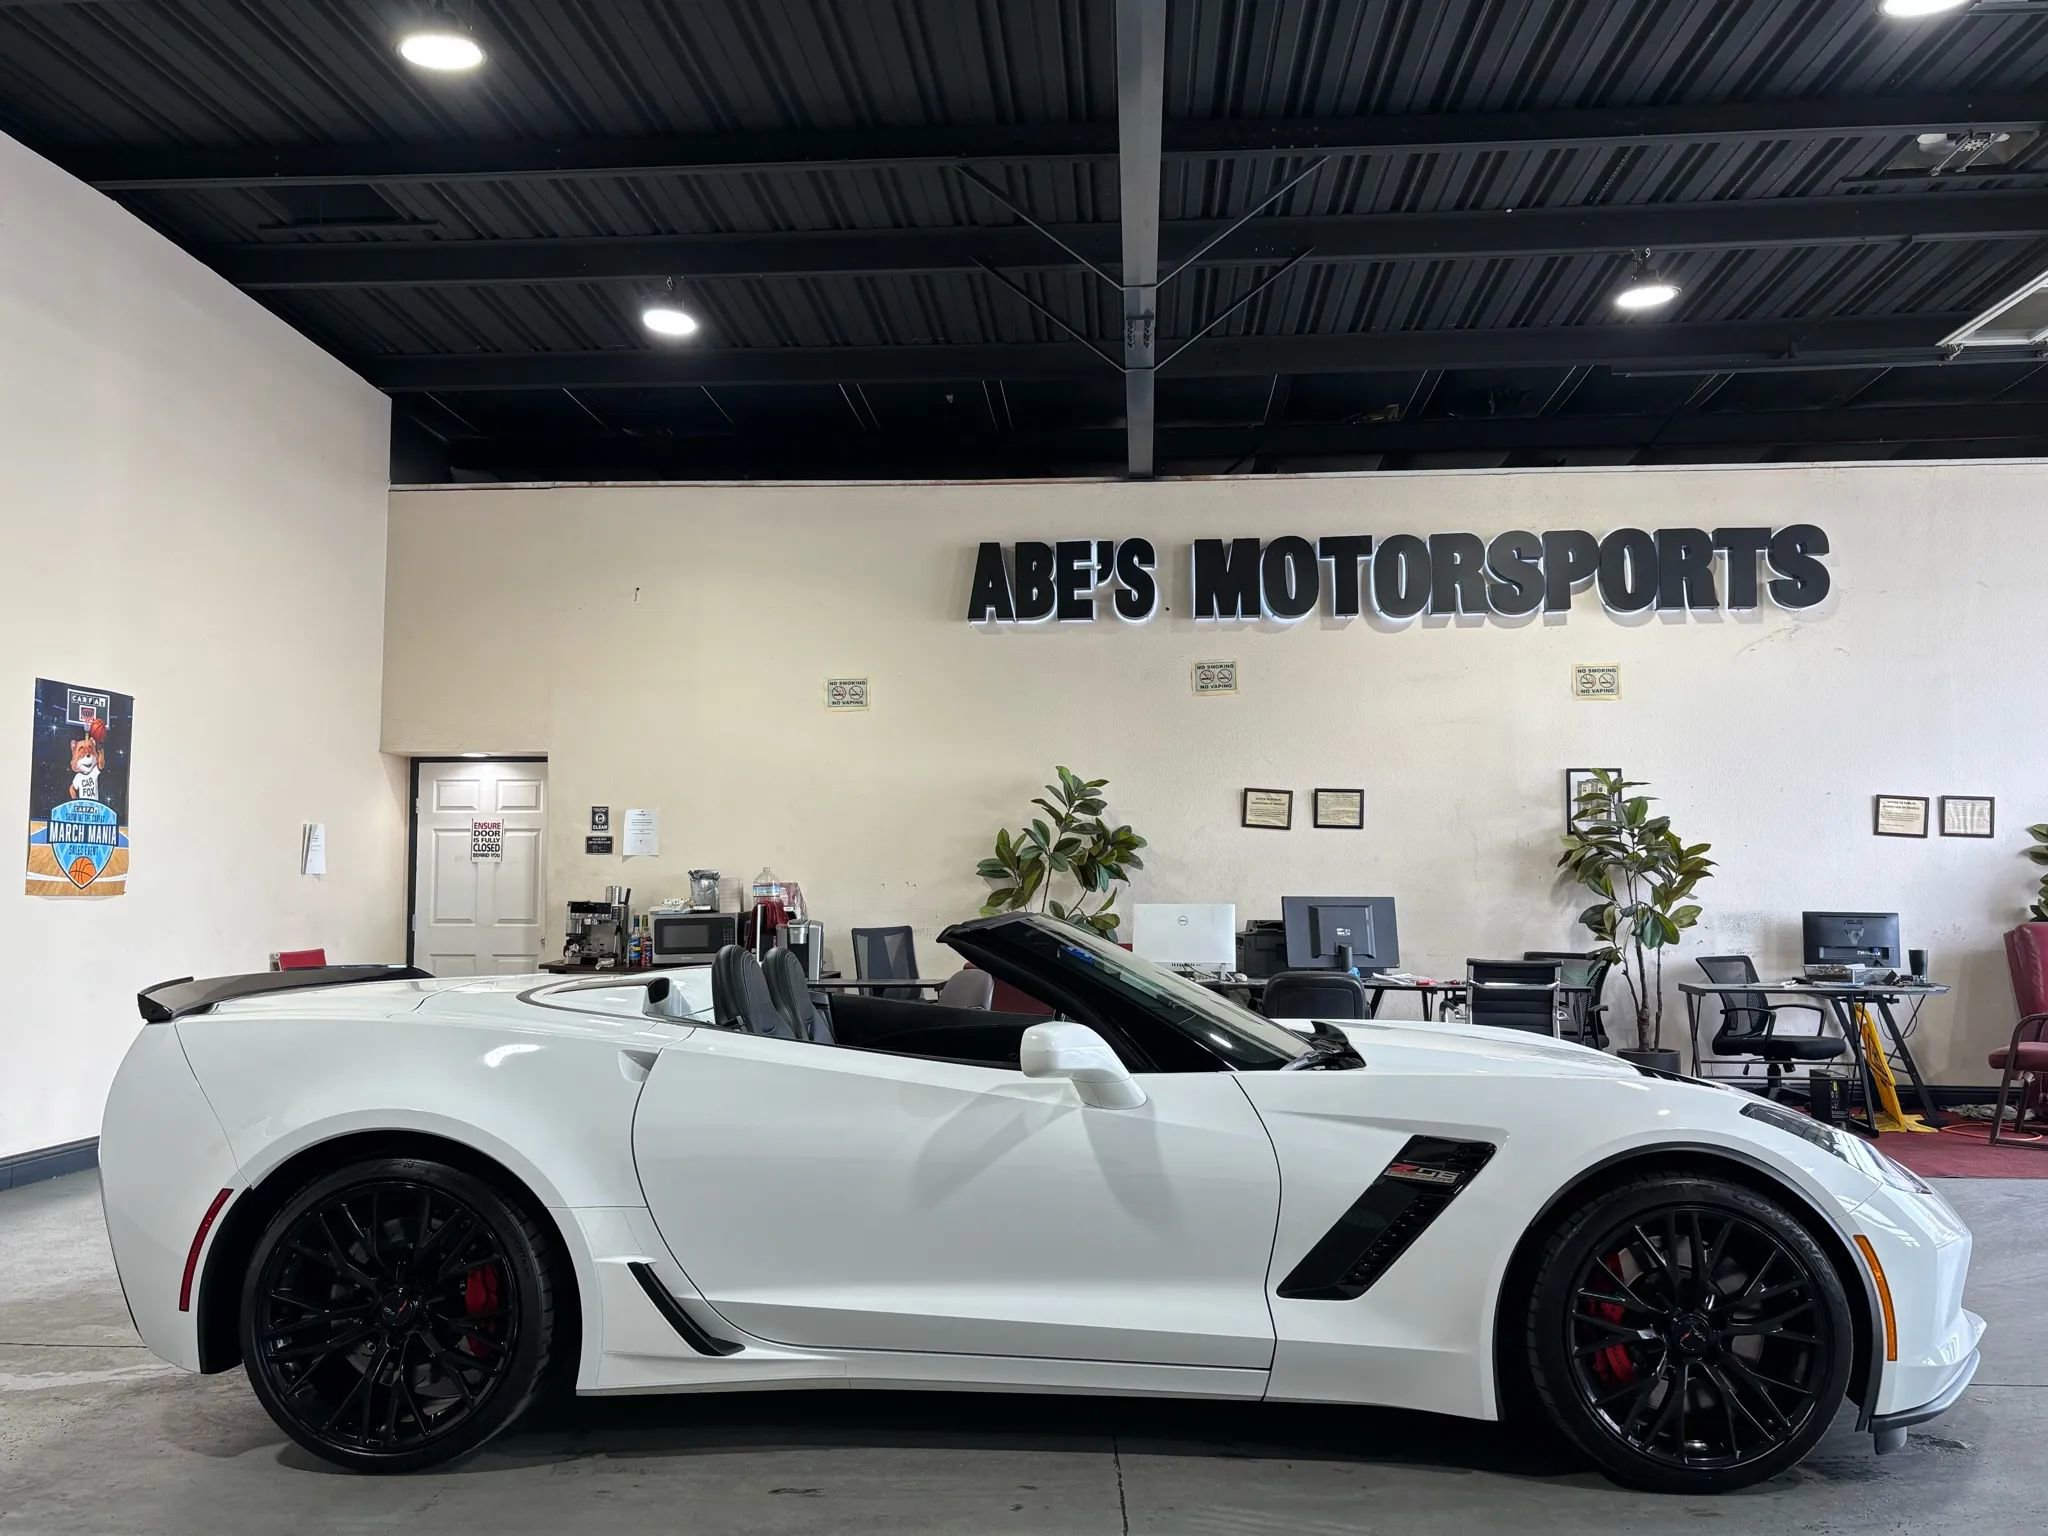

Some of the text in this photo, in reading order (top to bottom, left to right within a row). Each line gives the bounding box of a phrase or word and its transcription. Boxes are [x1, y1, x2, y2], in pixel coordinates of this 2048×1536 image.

[968, 524, 1831, 622] ABE'S MOTORSPORTS
[82, 777, 95, 787] CAR
[82, 787, 95, 797] FOX
[49, 822, 117, 845] MARCH MANIA
[69, 845, 83, 855] SALES
[473, 843, 500, 852] CLOSED
